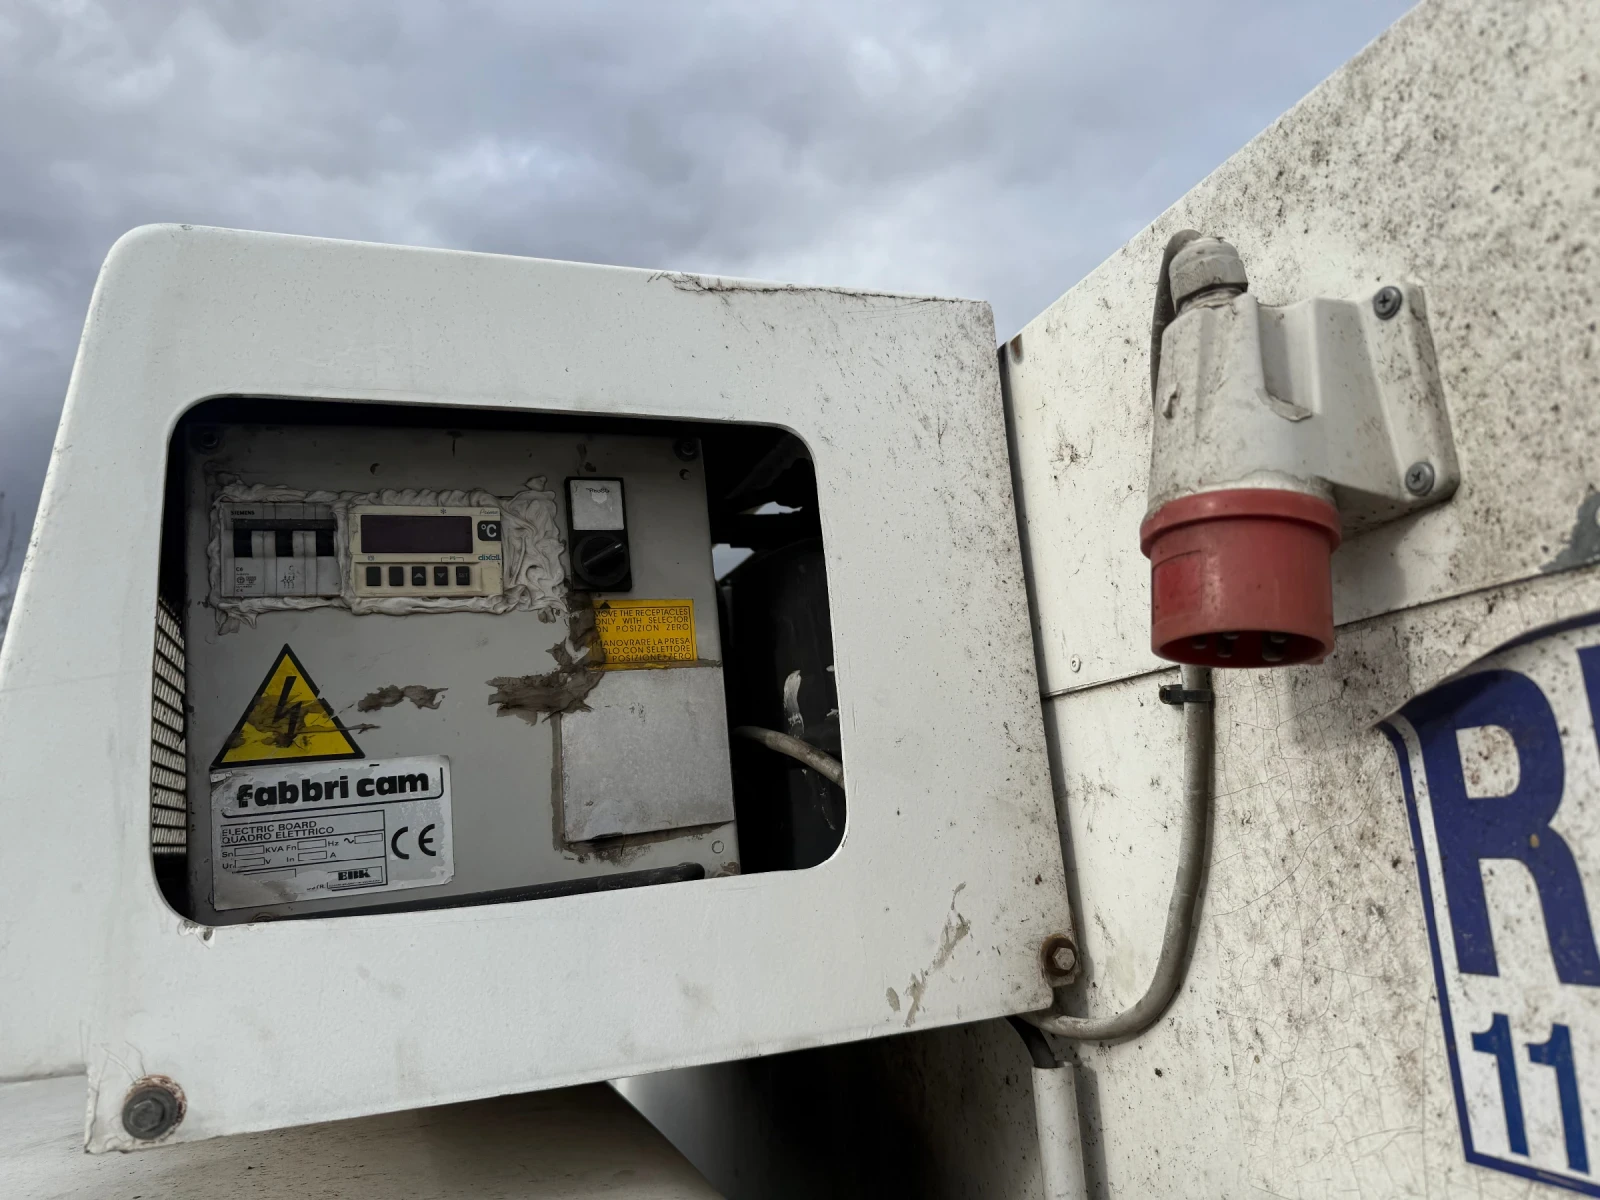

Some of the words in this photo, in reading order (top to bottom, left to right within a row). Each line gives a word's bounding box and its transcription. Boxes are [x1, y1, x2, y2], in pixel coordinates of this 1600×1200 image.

[481, 523, 497, 538] °C
[620, 609, 634, 617] THE
[635, 608, 689, 616] RECEPTACLES
[594, 617, 616, 626] ONLY
[623, 617, 642, 625] WITH
[648, 616, 689, 624] SELECTOR
[597, 625, 609, 633] ON
[616, 624, 659, 632] POSIZION
[666, 623, 690, 631] ZERO
[653, 638, 664, 646] LA
[664, 637, 691, 646] PRESA
[622, 646, 644, 654] CON
[646, 644, 691, 654] SELETTORE
[612, 653, 663, 662] POSIZIONE
[236, 775, 349, 809] fabbri
[356, 772, 430, 798] cam
[221, 823, 276, 838] ELECTRIC
[278, 820, 317, 832] BOARD
[221, 830, 272, 845] QUADRO
[275, 826, 335, 839] ELETTRICO
[221, 850, 234, 858] Sn
[265, 844, 285, 854] KVA
[286, 843, 297, 852] Fn
[327, 839, 340, 848] Hz
[390, 823, 437, 860] CE
[265, 857, 272, 865] V
[329, 851, 337, 859] A
